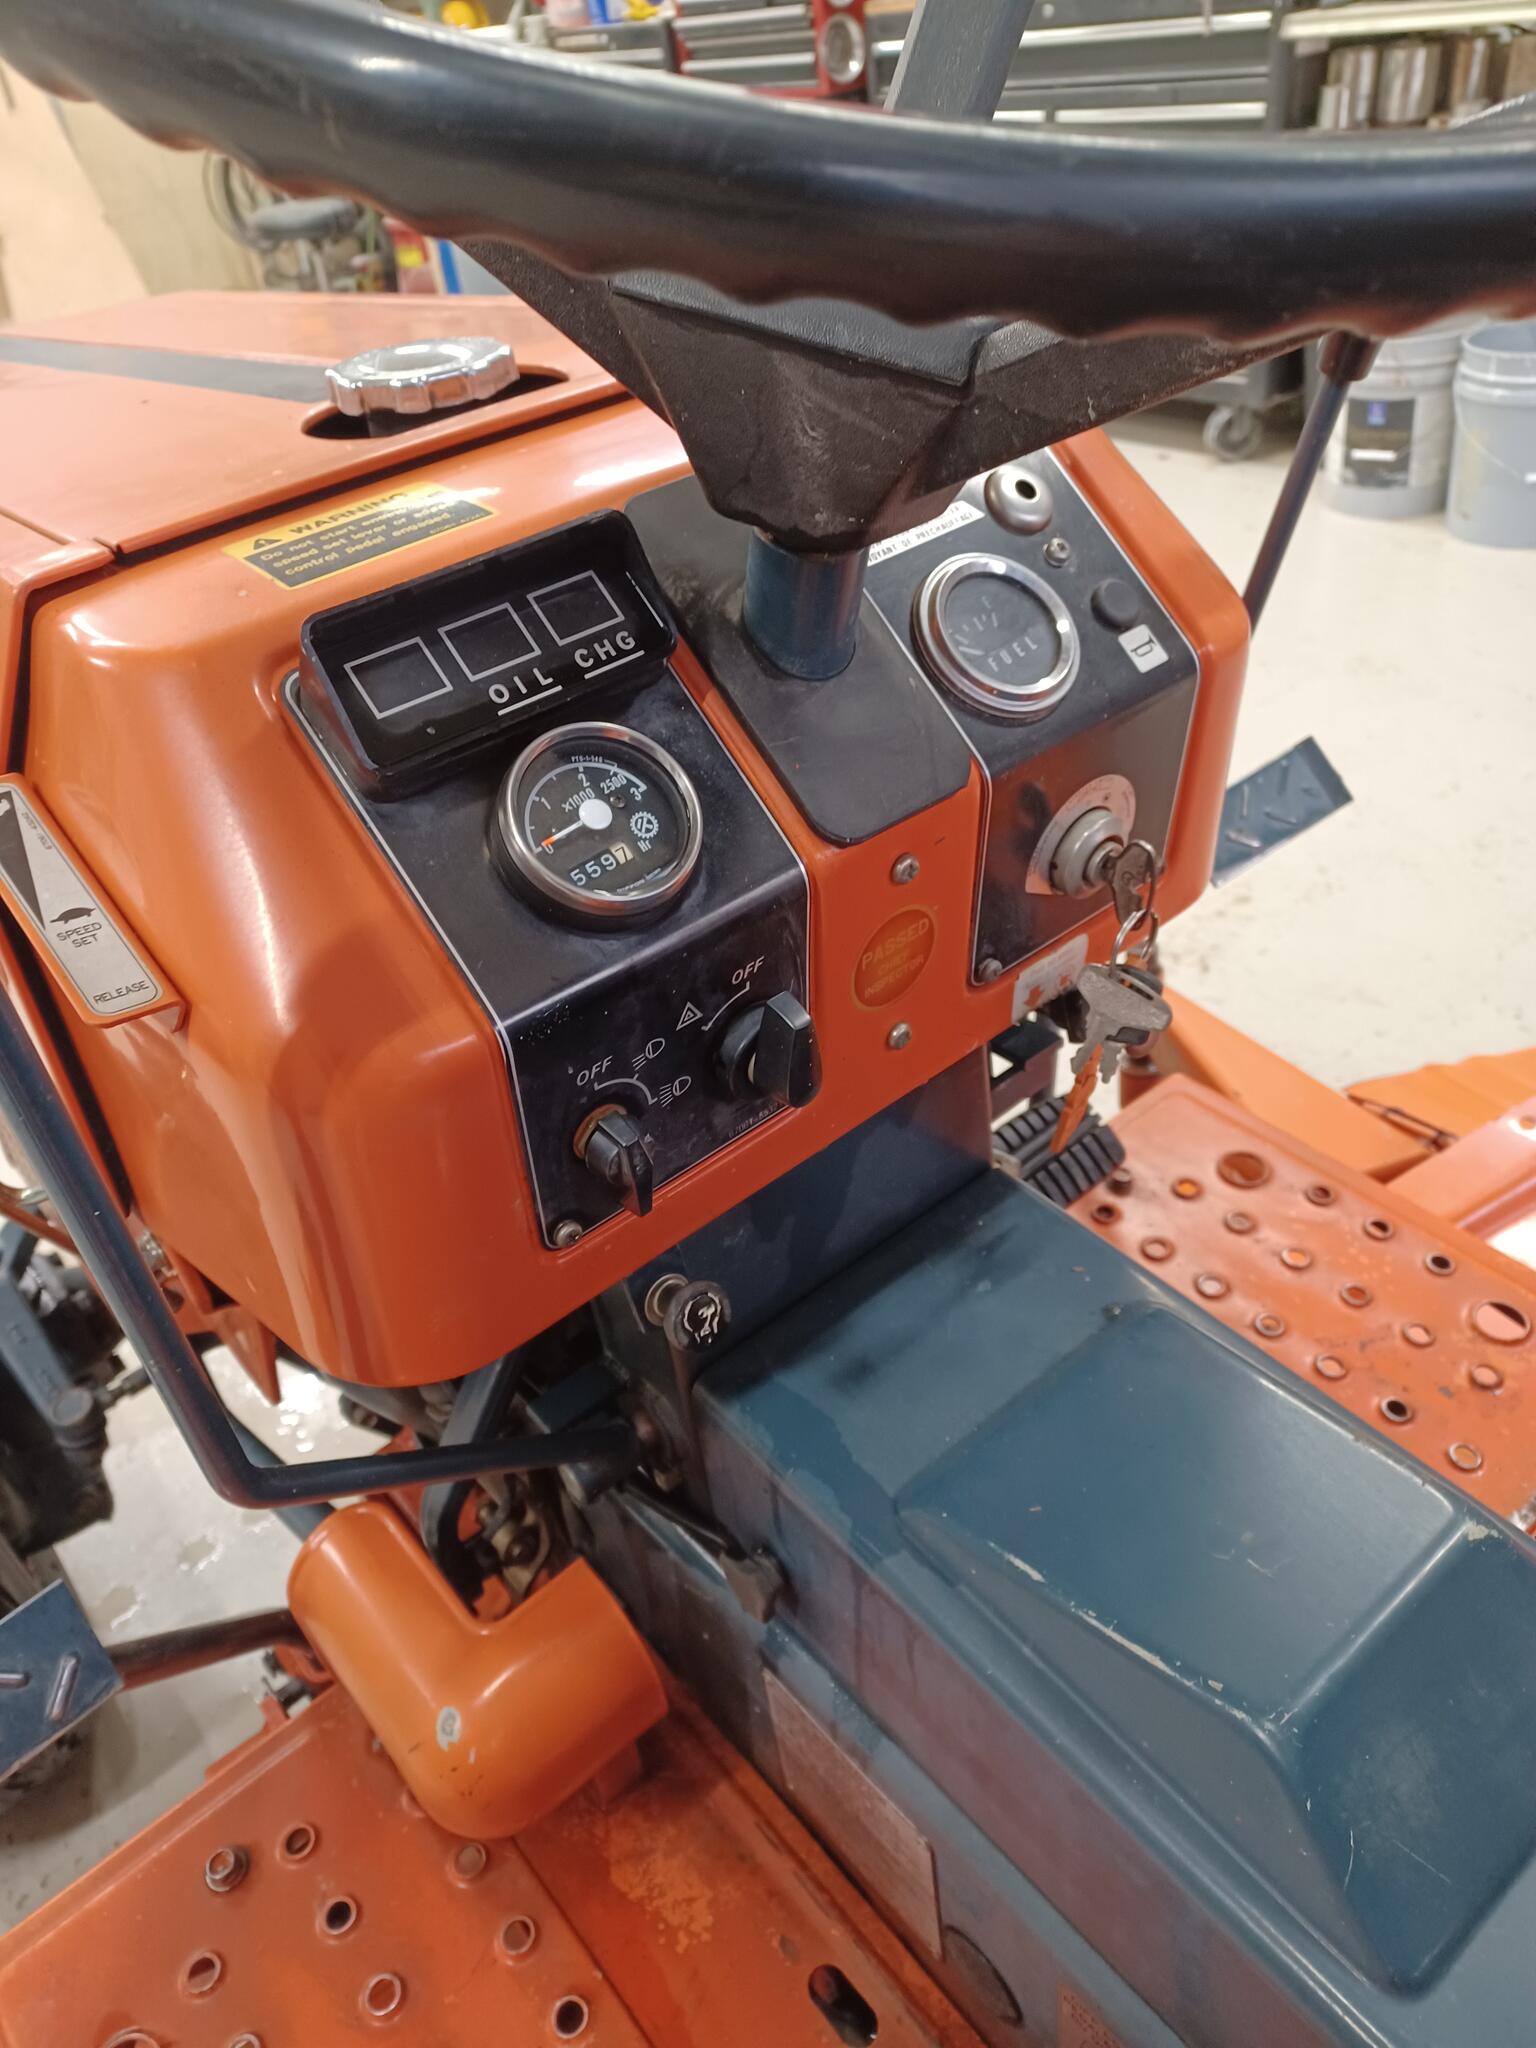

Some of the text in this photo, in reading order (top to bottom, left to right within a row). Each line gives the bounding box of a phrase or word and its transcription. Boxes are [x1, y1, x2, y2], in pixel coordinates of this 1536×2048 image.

[260, 550, 284, 562] Do
[288, 540, 315, 552] not
[319, 525, 357, 541] start
[272, 547, 320, 568] speed
[322, 537, 349, 551] set
[350, 524, 387, 540] lever
[284, 551, 340, 576] control
[488, 630, 636, 704] OIL CHG
[987, 635, 1039, 673] FUEL
[577, 773, 591, 788] 2
[600, 774, 628, 796] 2500
[56, 921, 103, 942] SPEED
[71, 933, 100, 949] SET
[862, 917, 929, 972] PASSED
[731, 955, 766, 986] OFF
[93, 980, 150, 1004] RELEASE
[576, 1054, 614, 1087] OFF
